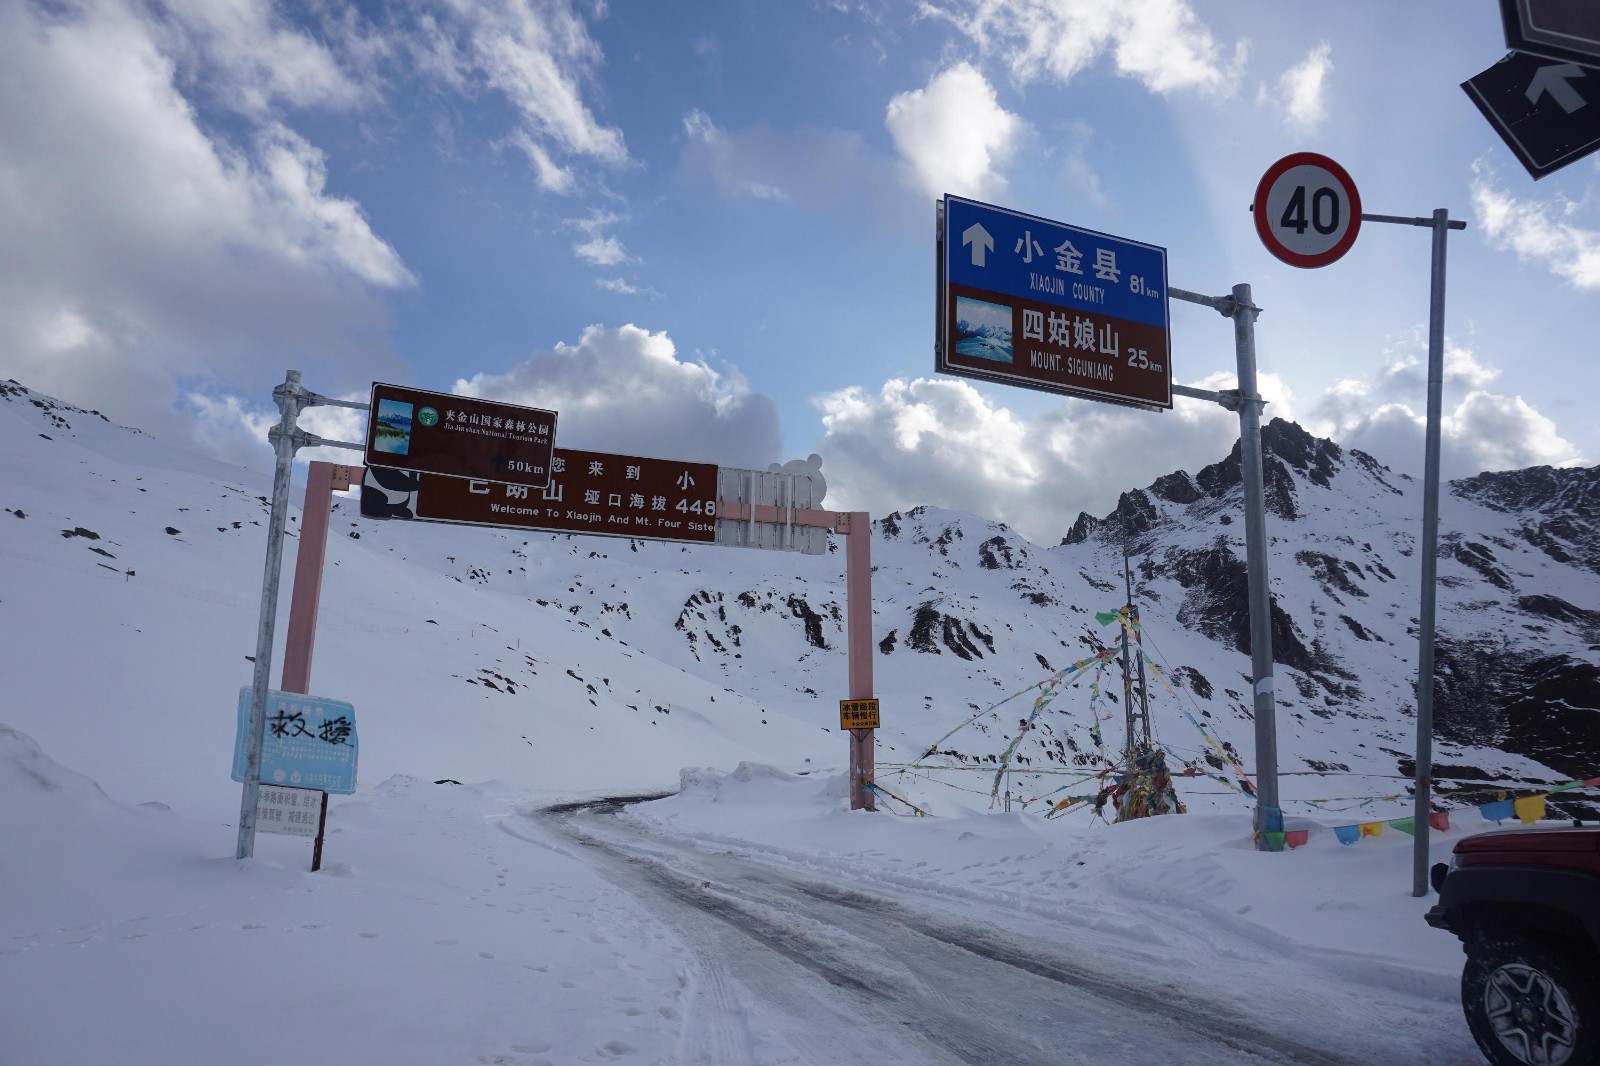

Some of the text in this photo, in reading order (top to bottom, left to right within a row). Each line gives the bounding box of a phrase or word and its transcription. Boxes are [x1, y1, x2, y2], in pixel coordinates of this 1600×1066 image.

[1281, 186, 1339, 235] 40
[1014, 230, 1121, 283] 小金县
[1030, 272, 1105, 305] XIAOJIN COUNTY
[1022, 308, 1119, 358] 四姑娘山
[1030, 350, 1114, 381] MOUNT. SIGUNIANG
[445, 409, 549, 436] 夹金山国家森林公园
[481, 428, 507, 439] National
[509, 432, 533, 443] Tourism
[534, 436, 548, 445] Park
[507, 460, 544, 474] 50km
[490, 503, 540, 516] Welcome
[546, 508, 559, 518] To
[566, 510, 602, 523] Xiaojin
[608, 514, 629, 524] And
[635, 516, 652, 526] Mt.
[658, 518, 682, 528] Four
